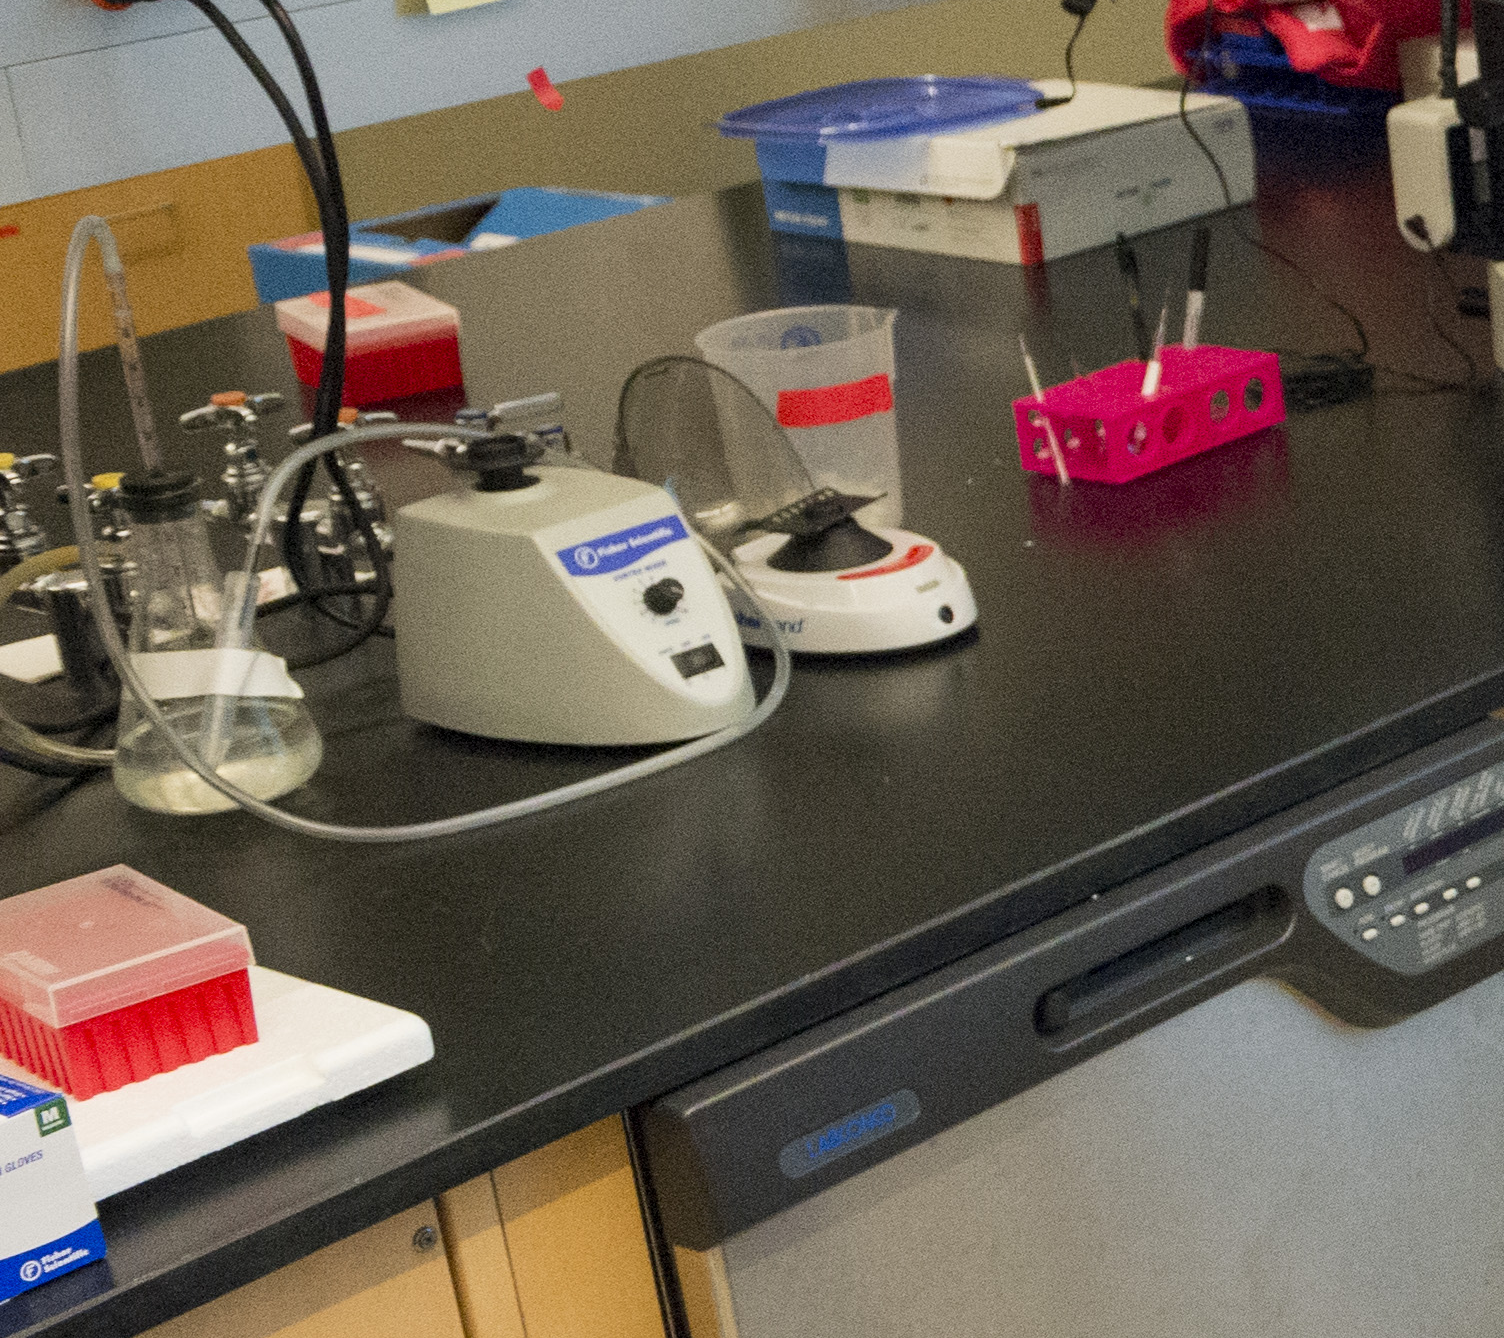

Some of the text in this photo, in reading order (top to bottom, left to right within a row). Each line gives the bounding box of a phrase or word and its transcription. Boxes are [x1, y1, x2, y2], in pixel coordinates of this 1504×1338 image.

[628, 527, 675, 548] Scientific
[40, 1107, 60, 1125] M
[5, 1150, 44, 1173] GLOVES
[44, 1249, 90, 1273] Scientific
